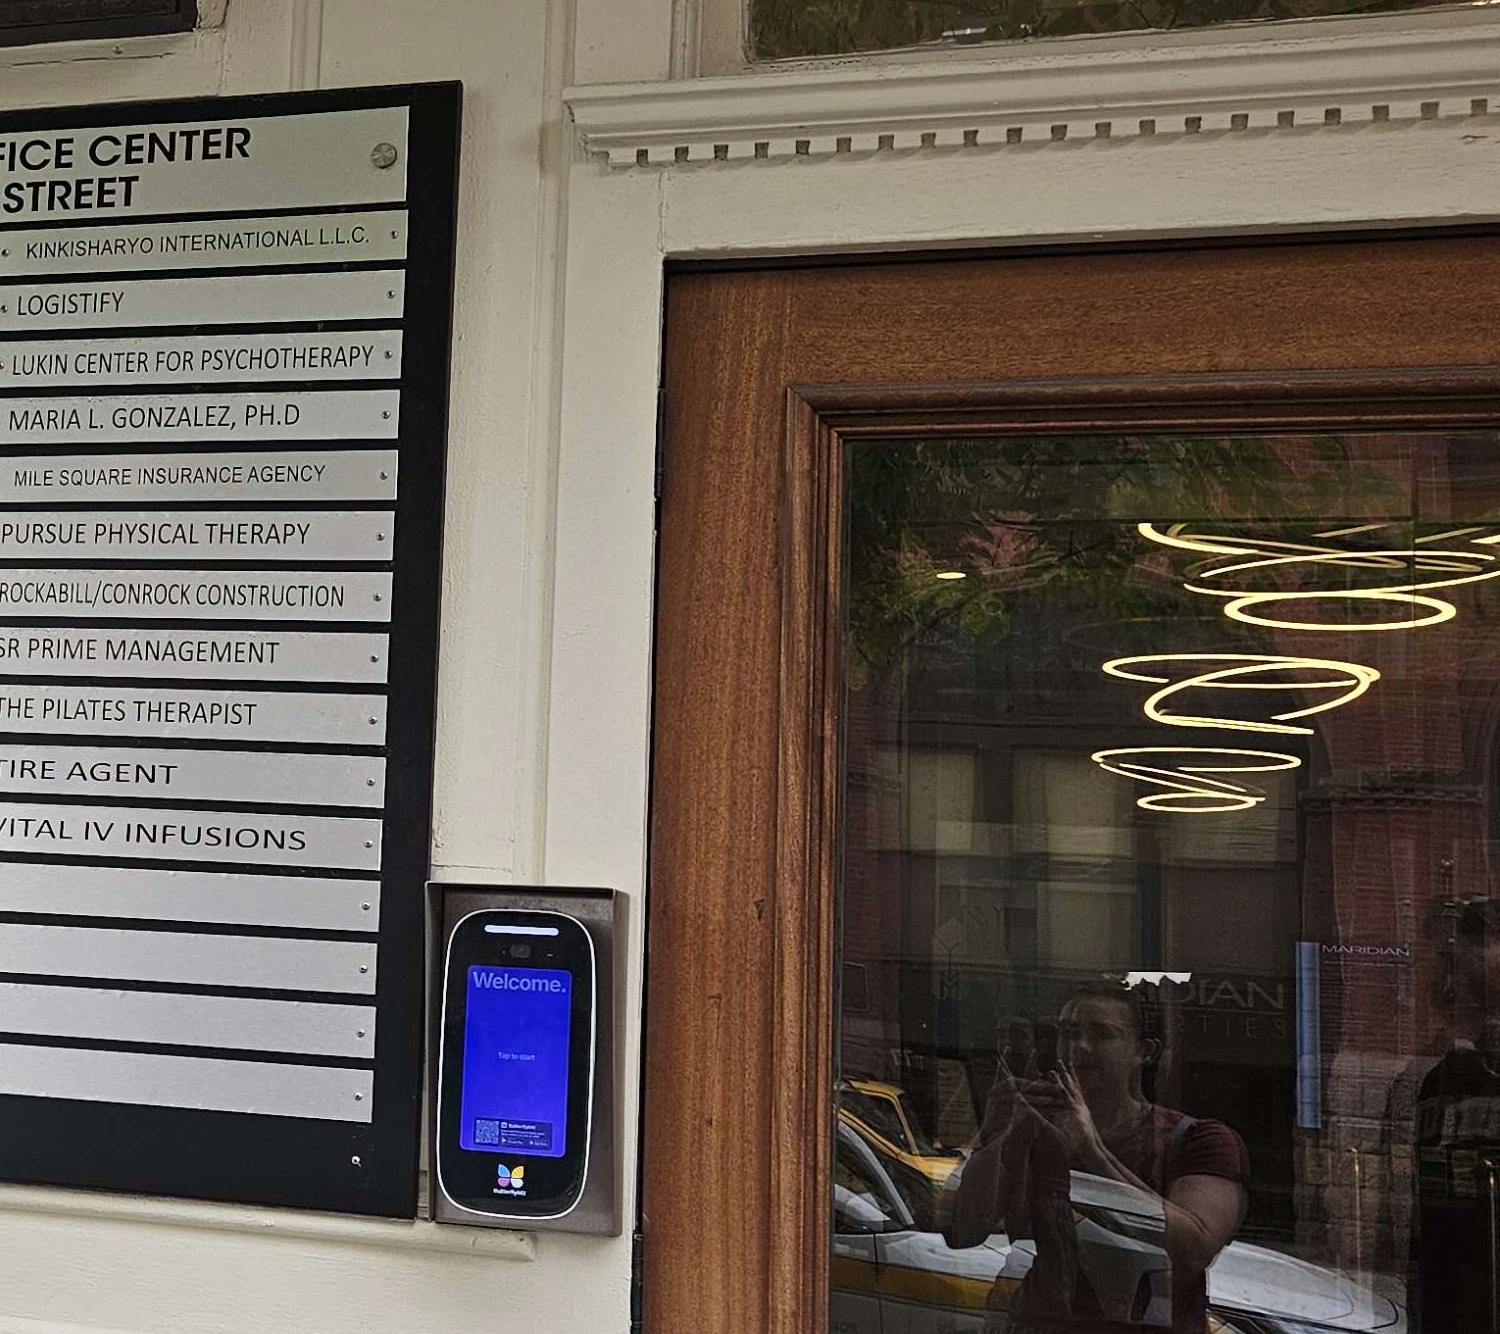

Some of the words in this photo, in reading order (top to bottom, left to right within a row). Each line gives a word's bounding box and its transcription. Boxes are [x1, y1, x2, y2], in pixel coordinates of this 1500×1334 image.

[87, 126, 251, 167] CENTER
[1, 174, 140, 214] STREET
[25, 236, 154, 260] KINKISHARYO
[159, 228, 315, 253] INTERNATIONAL
[318, 225, 370, 245] L.L.C.
[16, 290, 125, 316] LOGISTIFY
[11, 352, 68, 376] LUKIN
[73, 350, 149, 374] CENTER
[154, 349, 194, 372] FOR
[200, 344, 374, 371] PSYCHOTHERAPY
[8, 408, 81, 431] MARIA
[87, 407, 104, 429] L.
[111, 404, 236, 431] GONZALEZ,
[244, 402, 300, 427] PH.D
[13, 468, 54, 487] MILE
[58, 467, 132, 487] SQUARE
[136, 465, 243, 485] INSURANCE
[245, 463, 326, 484] AGENCY
[0, 522, 87, 544] PURSUE
[93, 521, 199, 545] PHYSICAL
[203, 522, 311, 545] THERAPY
[195, 583, 344, 608] CONSTRUCTION
[26, 637, 98, 660] PRIME
[104, 638, 280, 664] MANAGEMENT
[41, 697, 126, 722] PILATES
[131, 699, 258, 726] THERAPIST
[65, 760, 179, 785] AGENT
[83, 820, 115, 842] IV
[125, 822, 306, 851] INFUSIONS
[472, 971, 567, 994] Welcome.
